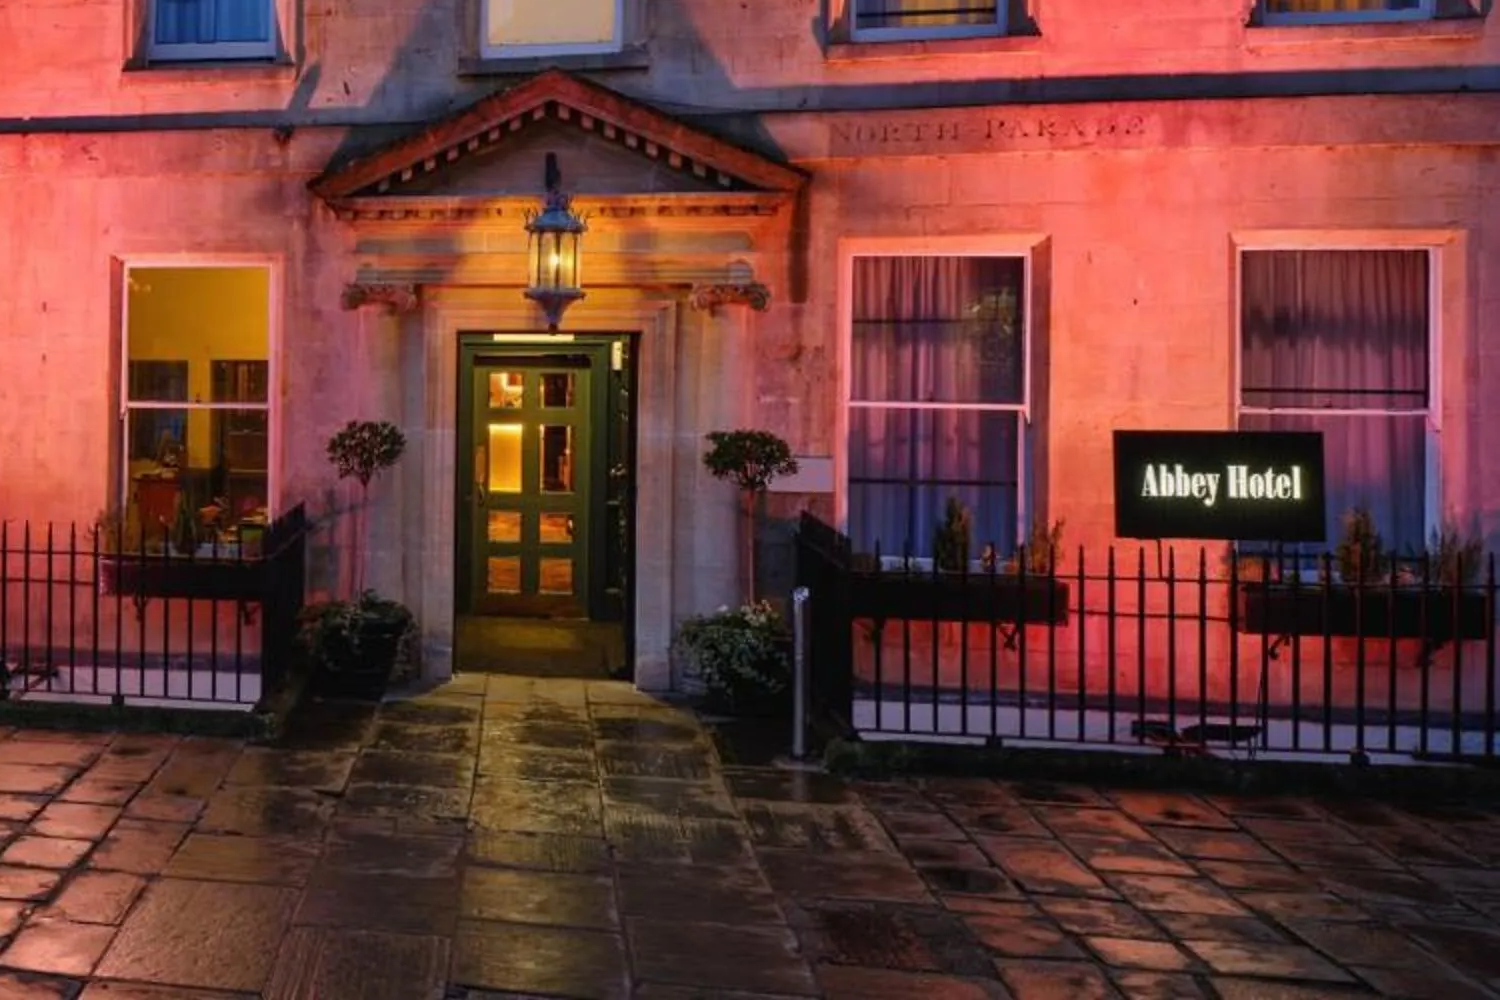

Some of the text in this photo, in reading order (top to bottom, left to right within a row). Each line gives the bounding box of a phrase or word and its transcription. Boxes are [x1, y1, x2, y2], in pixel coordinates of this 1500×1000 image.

[828, 120, 961, 144] NORTH
[1141, 463, 1302, 506] Abbey Hotel
